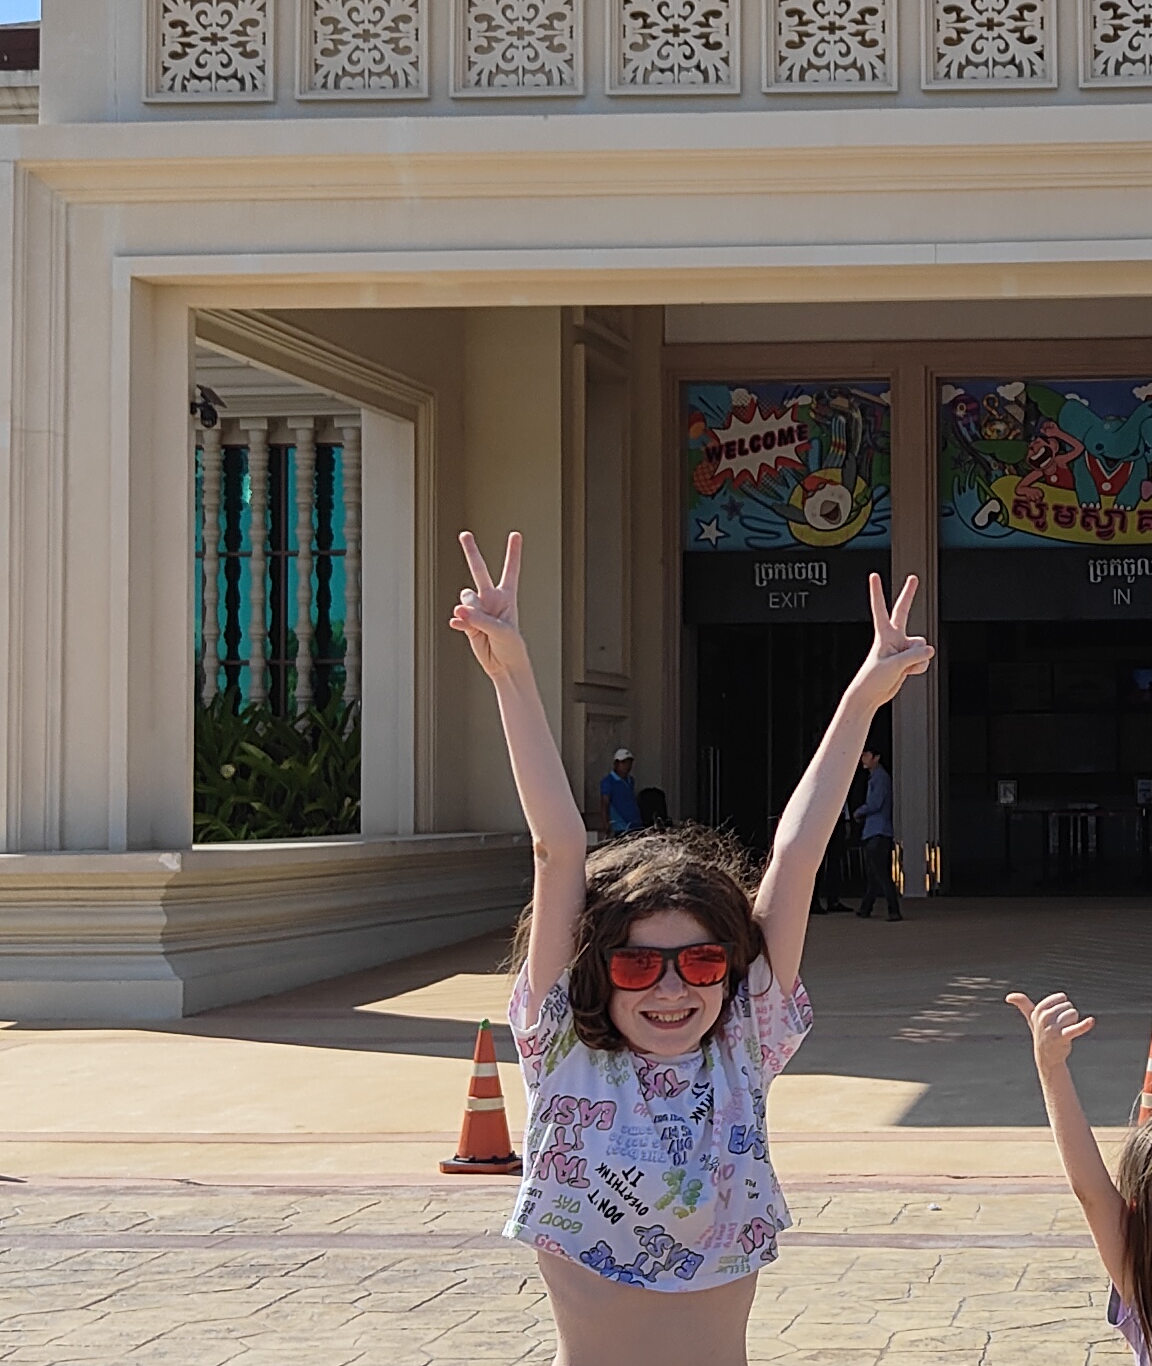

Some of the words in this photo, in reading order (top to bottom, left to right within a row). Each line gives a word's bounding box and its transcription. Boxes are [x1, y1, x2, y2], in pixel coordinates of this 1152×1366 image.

[705, 423, 809, 463] WELCOME
[768, 591, 810, 609] EXIT
[1112, 589, 1131, 605] IN
[540, 1094, 617, 1131] EASY
[595, 1162, 650, 1216] OVERTHINK
[622, 1165, 645, 1187] IT
[539, 1211, 583, 1233] GOOD
[587, 1188, 626, 1225] DON'T
[633, 1224, 705, 1280] EASY
